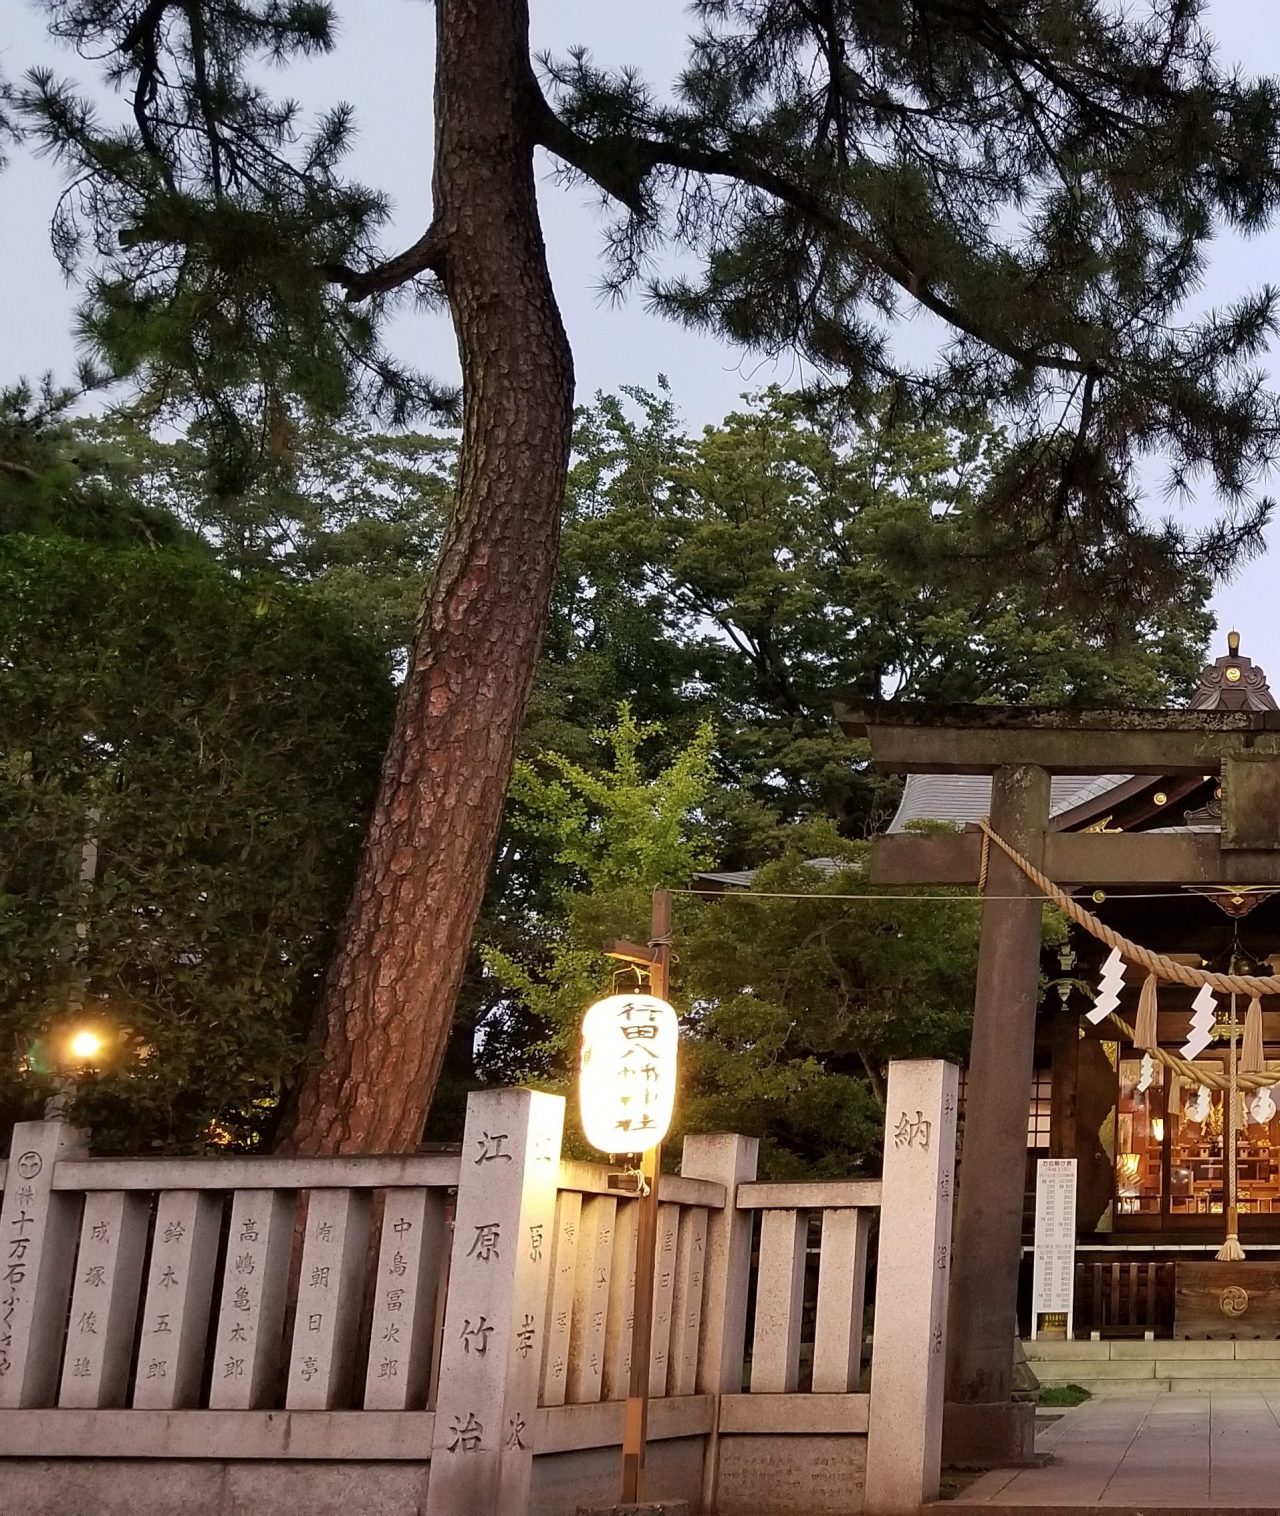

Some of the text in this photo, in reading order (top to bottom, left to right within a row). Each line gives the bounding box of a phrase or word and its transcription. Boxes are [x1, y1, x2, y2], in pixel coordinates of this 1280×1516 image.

[614, 1002, 664, 1132] 行田八社
[893, 1109, 932, 1152] 納
[145, 1220, 187, 1379] 鈴木五郎
[446, 1132, 513, 1454] 江原竹治
